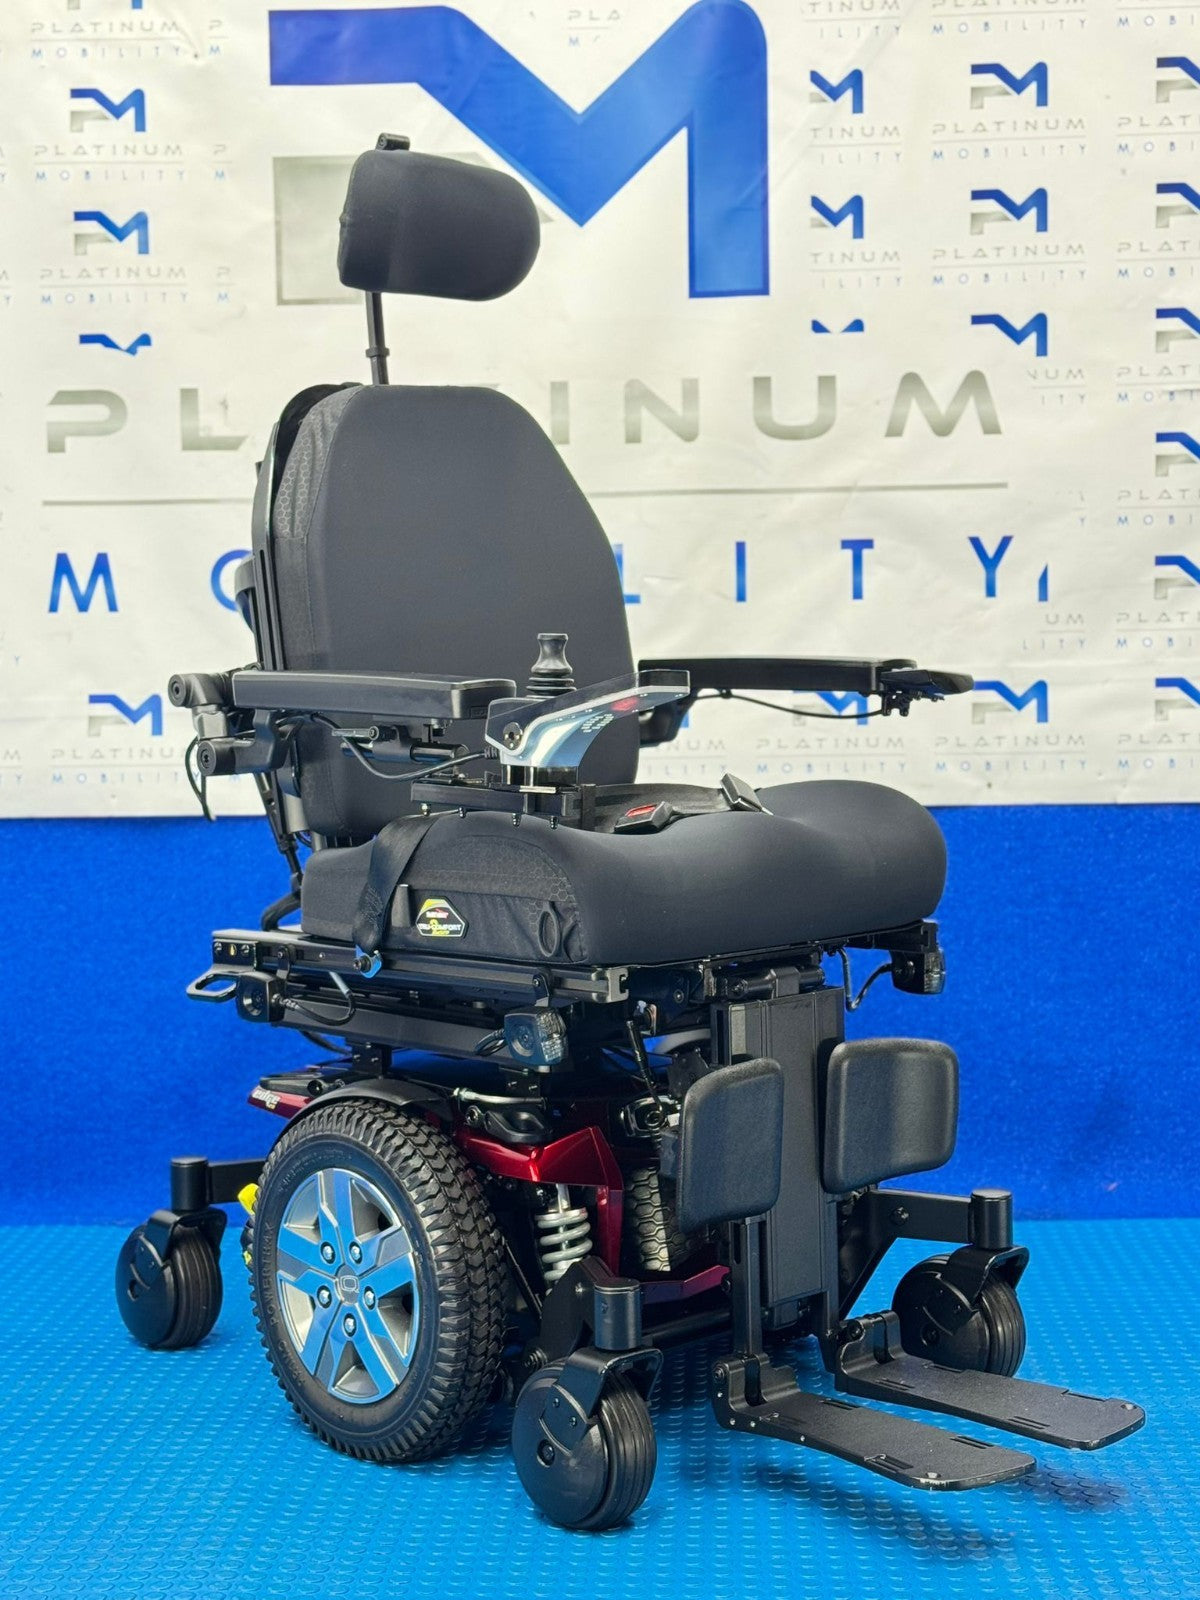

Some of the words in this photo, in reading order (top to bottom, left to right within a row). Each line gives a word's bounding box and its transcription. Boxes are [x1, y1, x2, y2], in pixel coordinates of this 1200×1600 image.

[31, 21, 180, 34] PLATINUM
[932, 18, 1086, 33] MOBILITY
[31, 46, 180, 58] MOBILITY
[932, 117, 1085, 135] PLATINUM
[35, 144, 183, 156] PLATINUM
[932, 144, 1086, 160] MOBILITY
[36, 169, 184, 181] MOBILITY
[932, 243, 1085, 260] PLATINUM
[40, 266, 186, 279] PLATINUM
[932, 270, 1086, 285] MOBILITY
[42, 292, 188, 304] MOBILITY
[46, 371, 1002, 453] PLINUM
[48, 536, 1014, 612] MLITY
[757, 736, 905, 750] PLATINUM
[935, 734, 1086, 748] PLATINUM
[52, 747, 185, 760] PLATINU
[757, 761, 906, 774] MOBILITY
[935, 759, 1087, 773] MOBILITY
